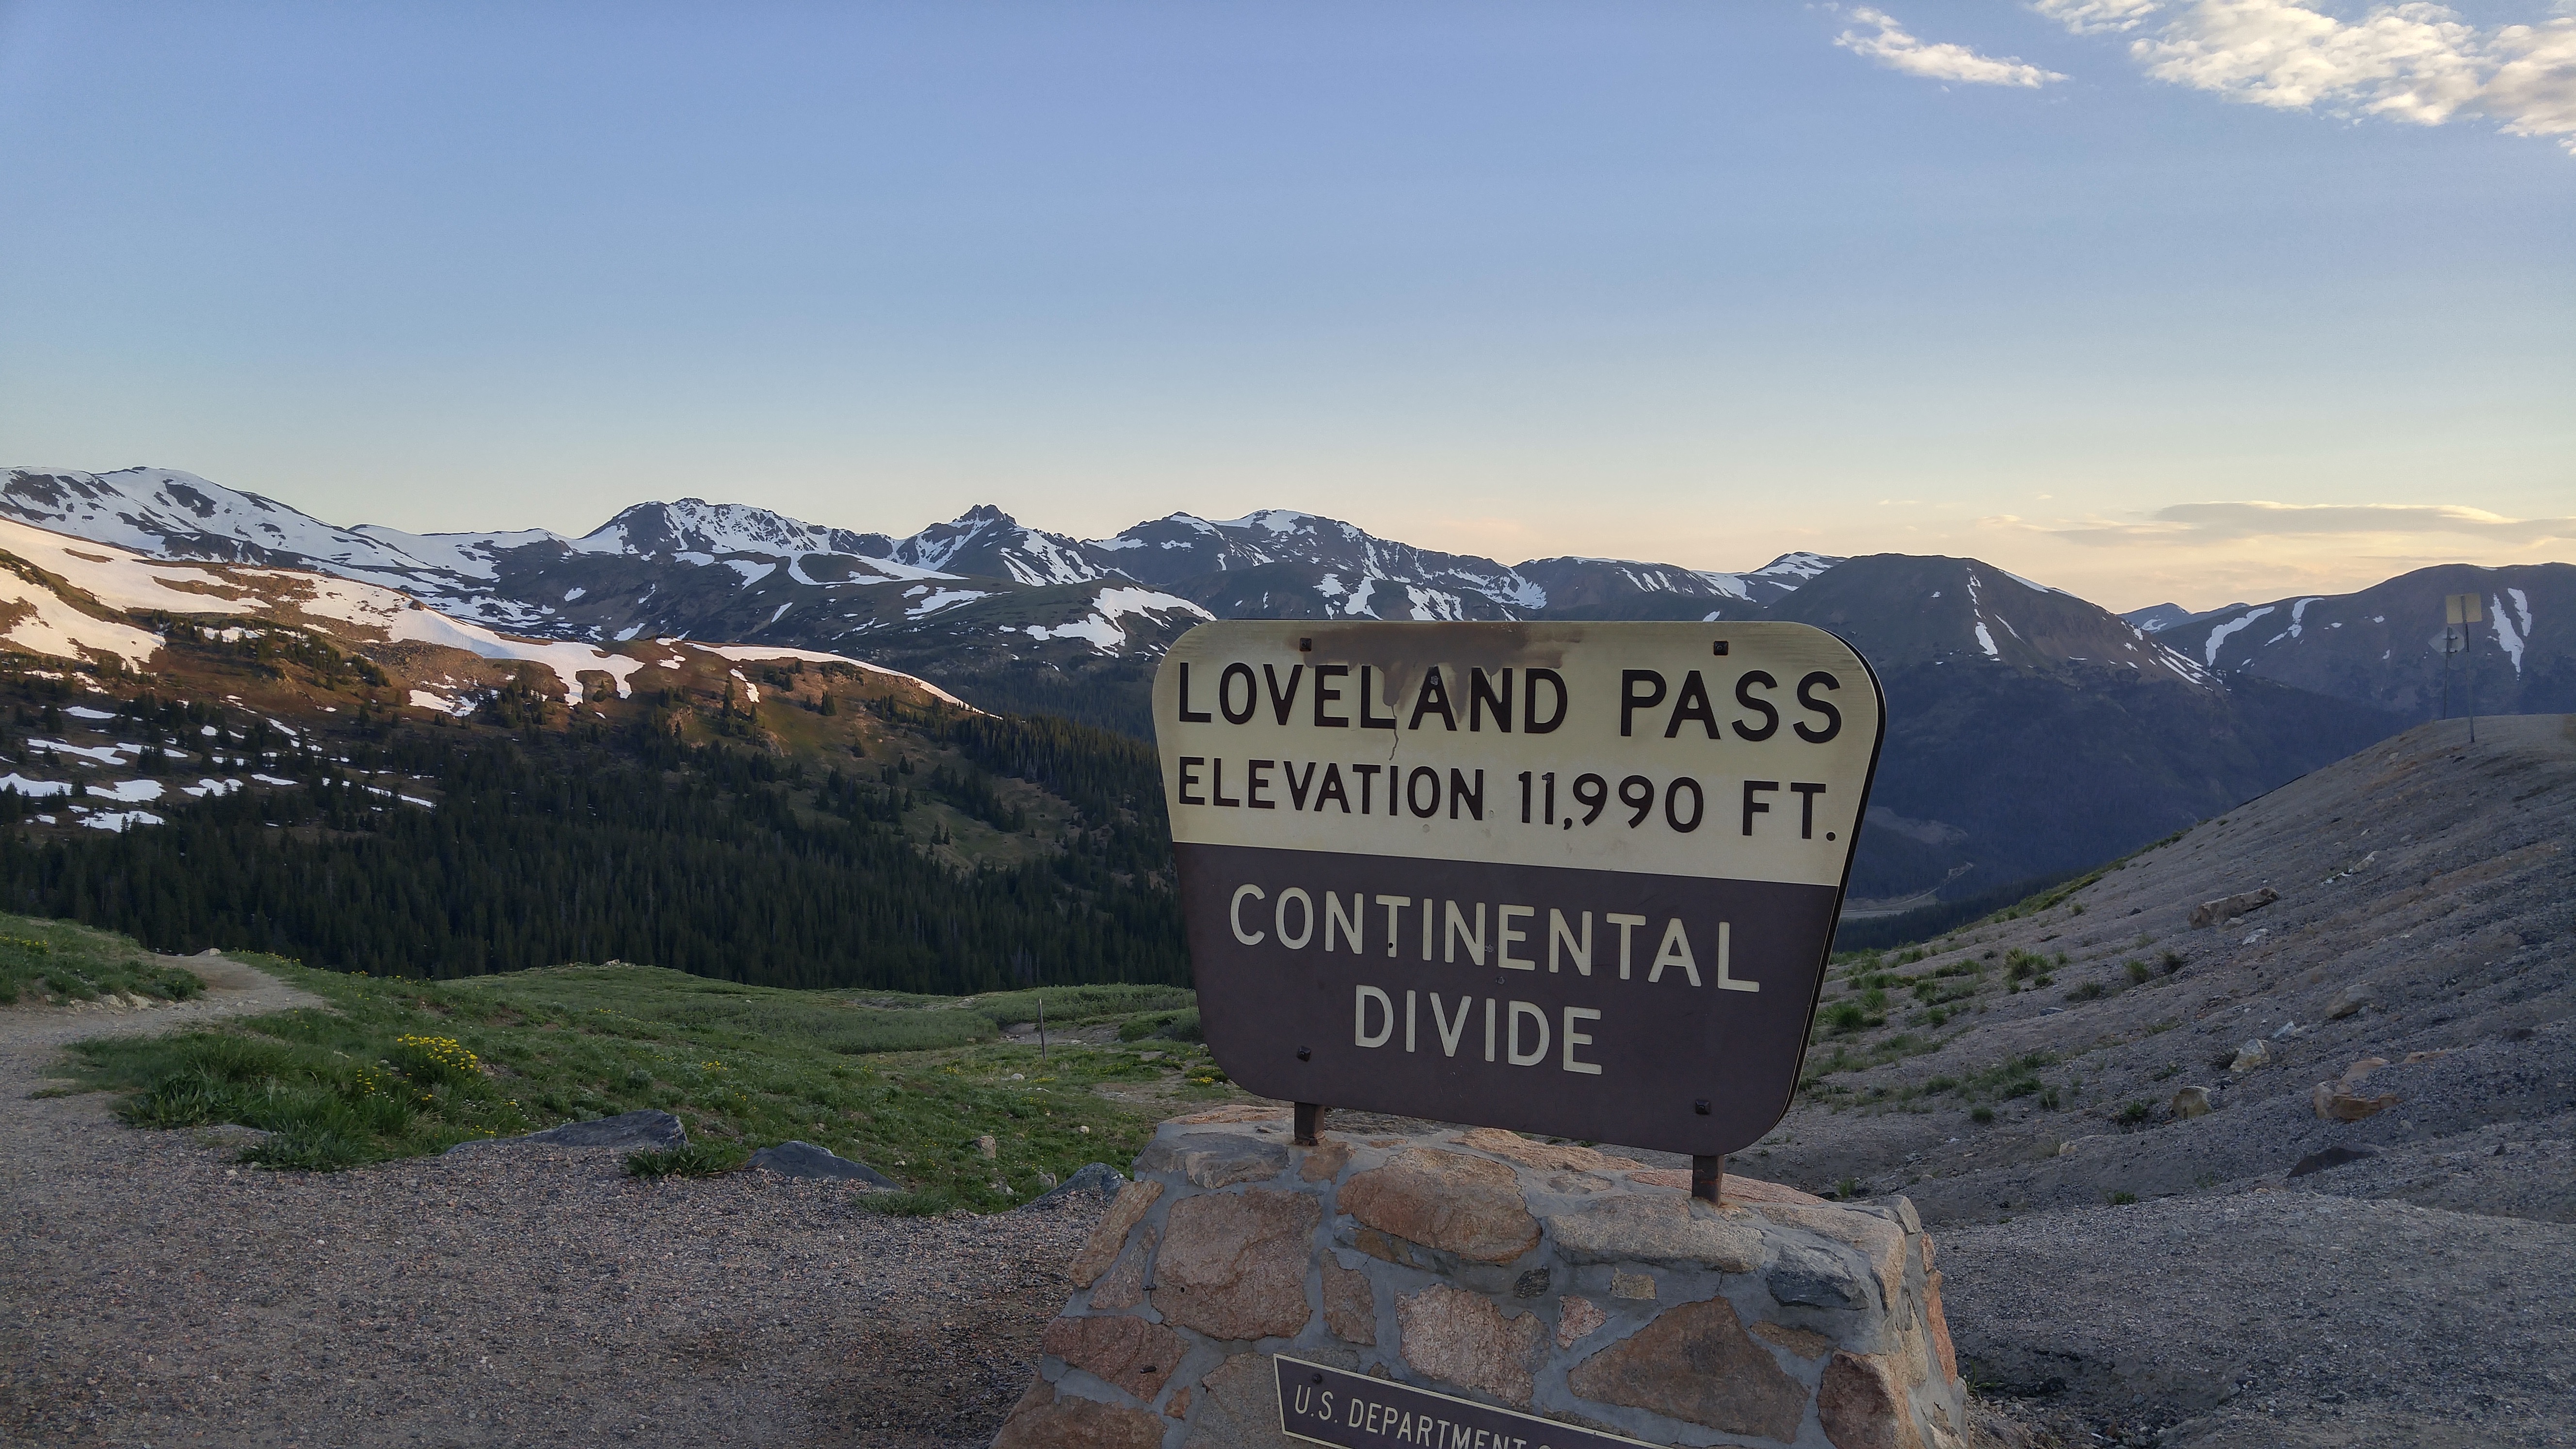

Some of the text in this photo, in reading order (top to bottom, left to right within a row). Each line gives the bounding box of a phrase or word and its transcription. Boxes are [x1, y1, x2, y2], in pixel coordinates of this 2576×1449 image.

[1178, 662, 1843, 744] LOVELAND PASS
[1178, 757, 1837, 843] ELEVATION 11,990 FT.
[1230, 884, 1760, 992] CONTINENTAL
[1355, 984, 1602, 1075] DIVIDE
[1295, 1384, 1338, 1424] U.S.
